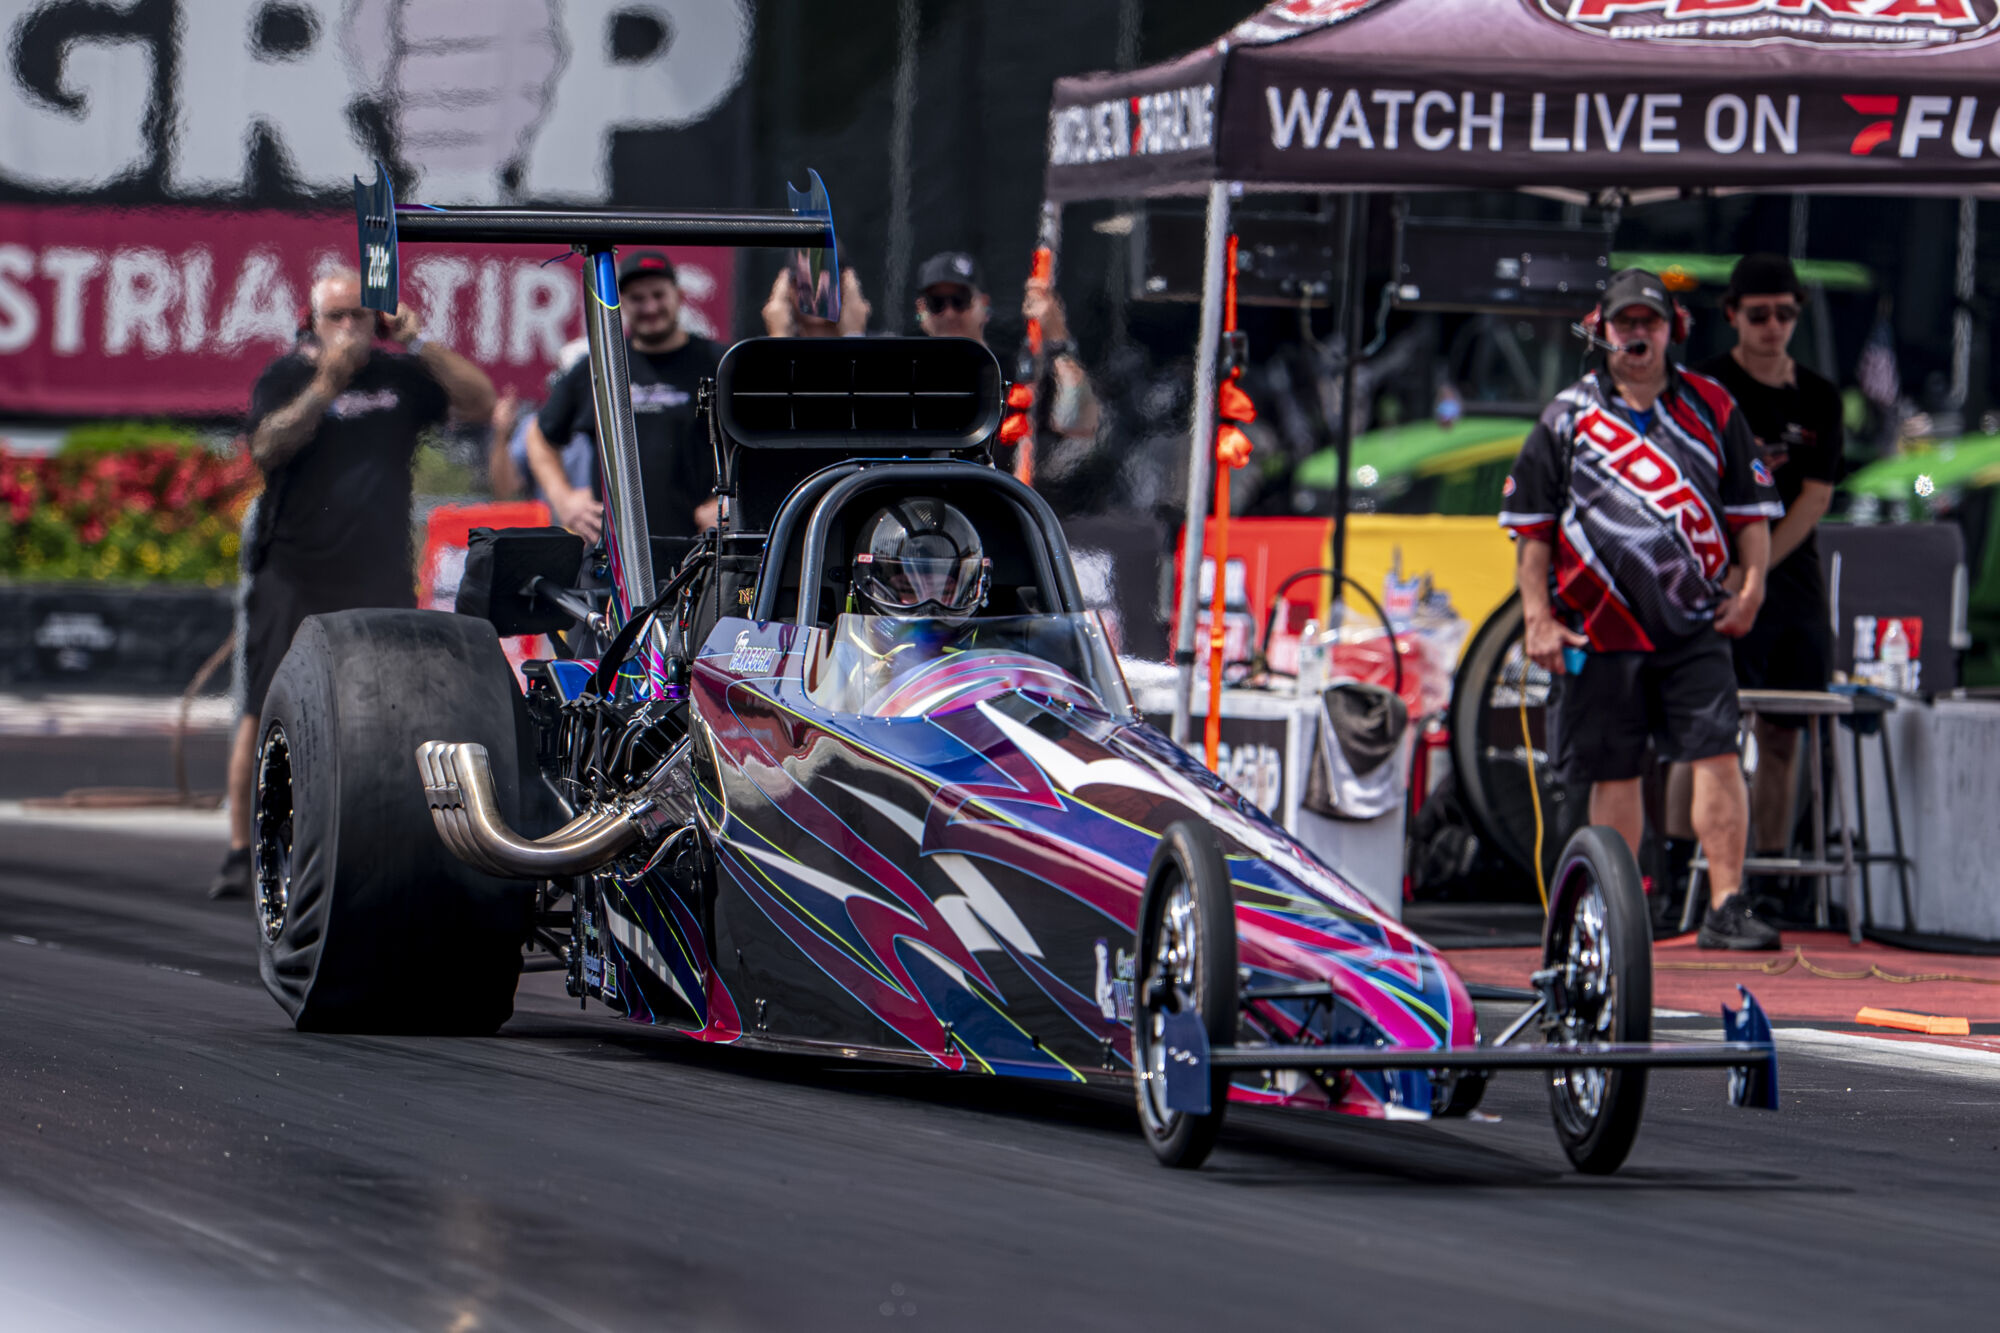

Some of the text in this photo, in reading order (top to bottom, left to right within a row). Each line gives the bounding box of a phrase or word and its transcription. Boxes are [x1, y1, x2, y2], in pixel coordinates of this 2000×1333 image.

[1609, 16, 1958, 43] DRAG RACING SERIES
[1265, 87, 1502, 150] WATCH
[1531, 93, 1687, 152] LIVE
[1705, 94, 1799, 154] ON
[1898, 95, 2000, 159] FL
[1574, 401, 1729, 584] PDRA
